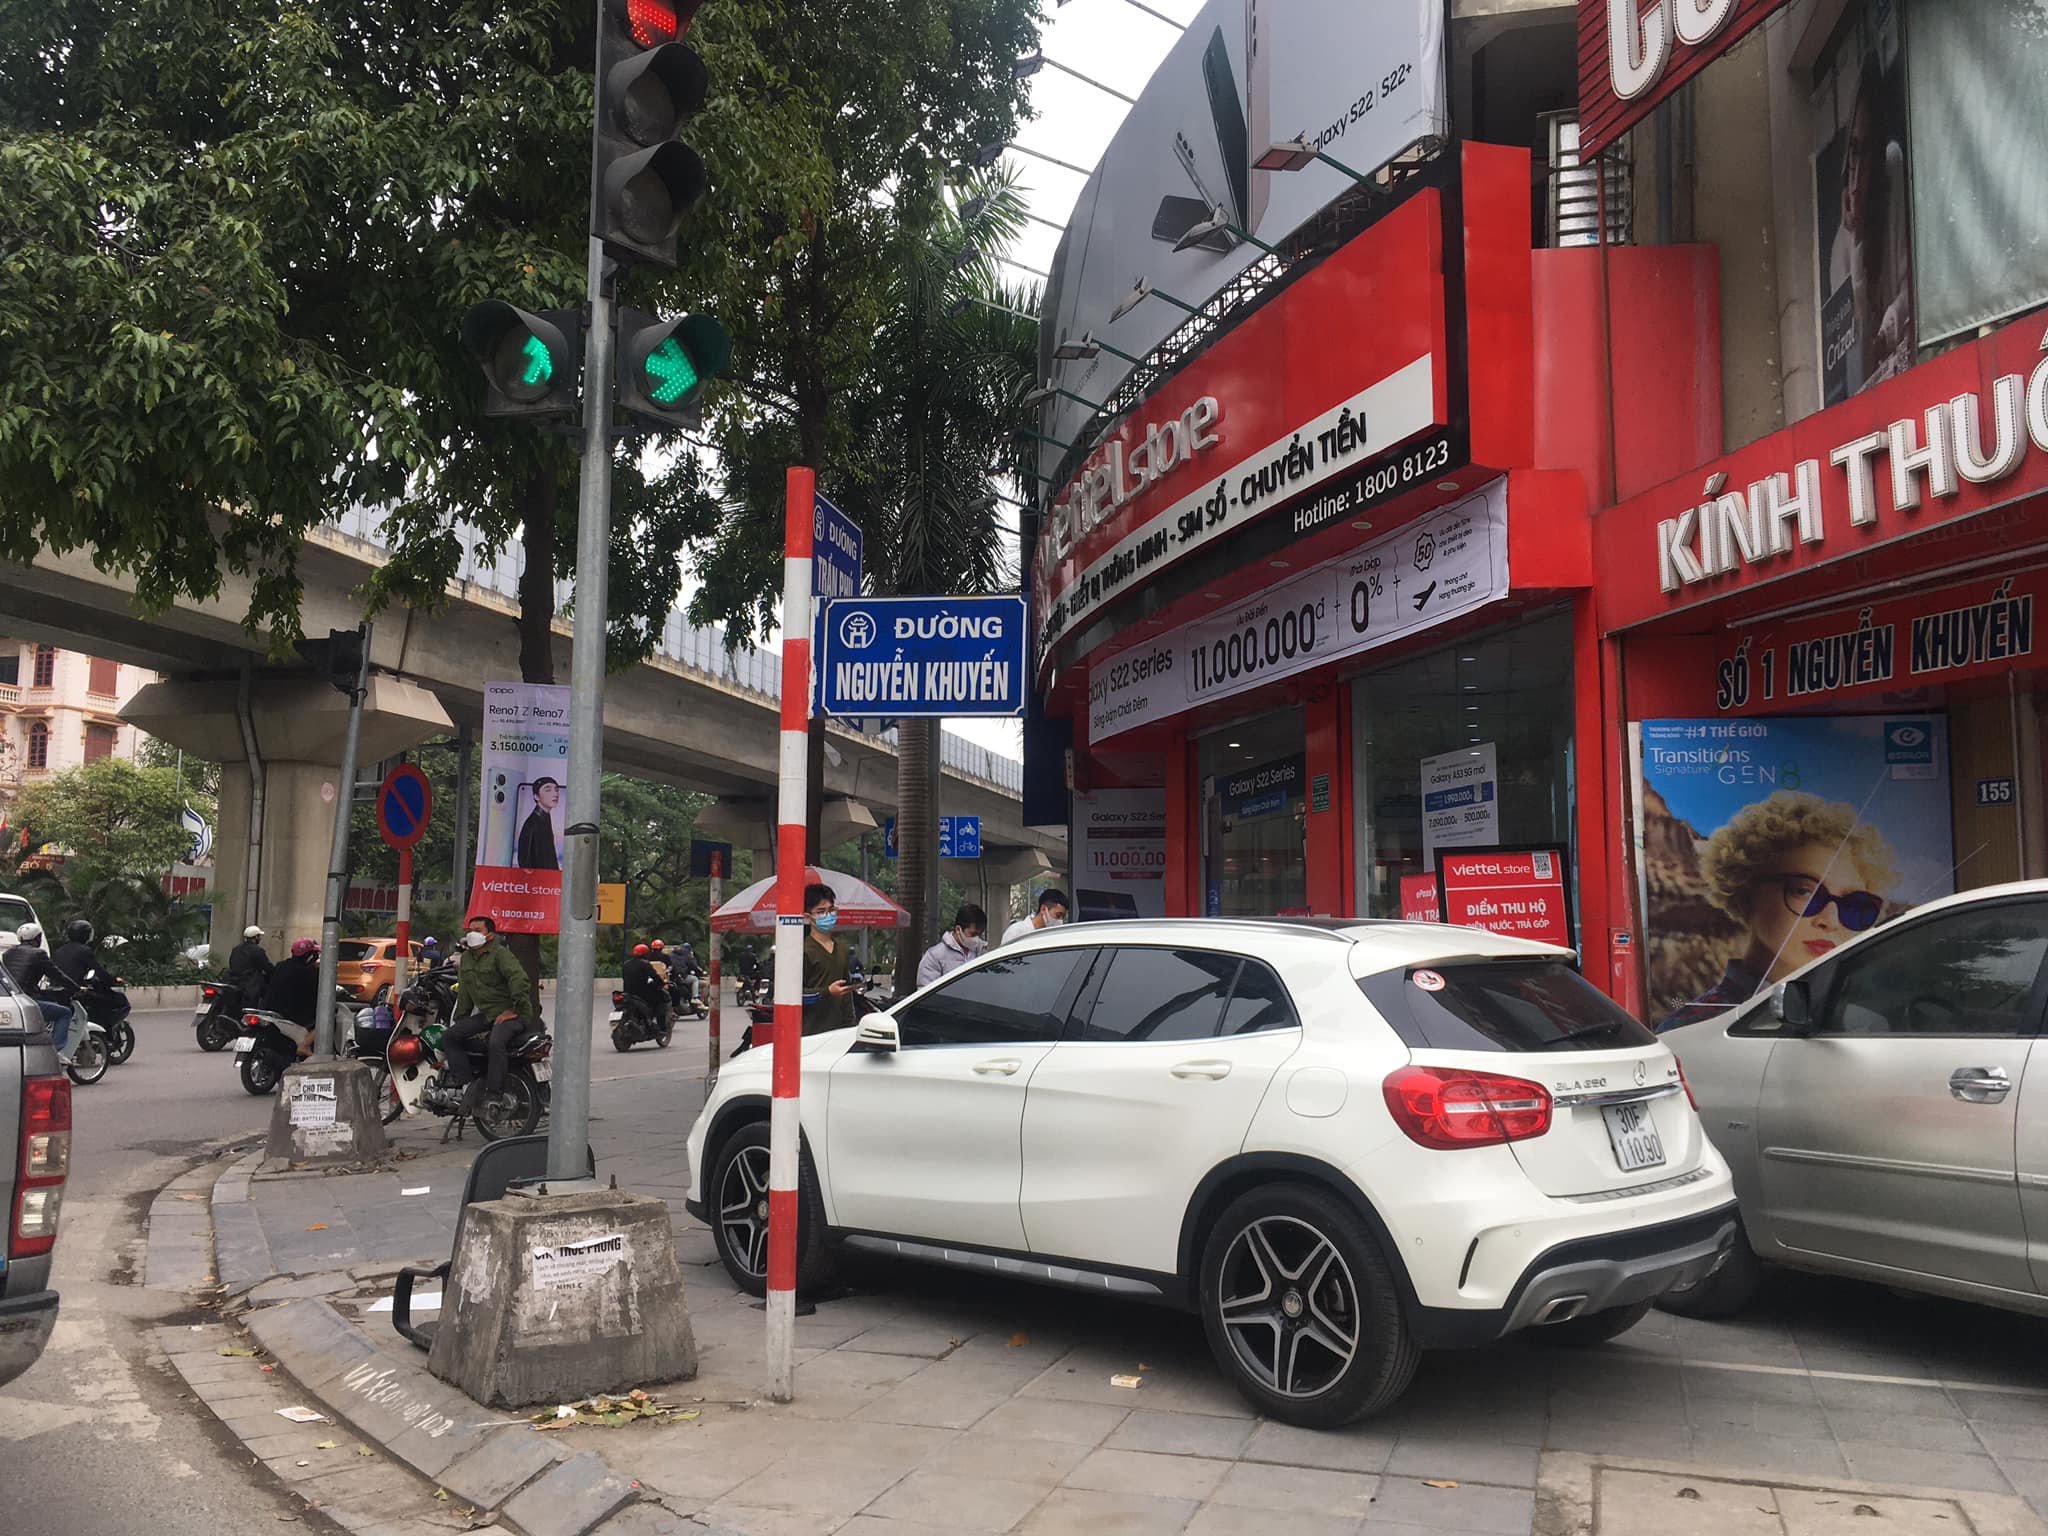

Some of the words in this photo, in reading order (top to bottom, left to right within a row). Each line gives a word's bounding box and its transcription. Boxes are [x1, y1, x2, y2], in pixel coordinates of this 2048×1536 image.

[1306, 112, 1348, 152] alaxy
[1350, 90, 1374, 125] S22
[1381, 63, 1413, 99] S22+
[1125, 396, 1220, 499] store
[1178, 506, 1204, 543] SIM
[1205, 478, 1228, 526] SỐ
[1240, 433, 1315, 507] CHUYỂN
[1293, 490, 1351, 533] Hotline:
[1355, 465, 1398, 504] 1800
[1402, 440, 1449, 483] 8123
[829, 520, 858, 562] ĐƯỜNG
[1657, 459, 1825, 594] KÍNH
[894, 610, 1003, 639] ĐƯỜNG
[1717, 637, 1751, 710] SỐ
[1761, 648, 1775, 700] 1
[1787, 606, 1894, 696] NGUYỄN
[1911, 577, 2033, 674] KHUYẾN
[835, 647, 919, 702] NGUYỄN
[924, 648, 1009, 702] KHUYẾN
[1110, 661, 1130, 693] S22
[1132, 648, 1173, 683] Series
[489, 704, 519, 716] Reno7
[522, 706, 530, 717] Z
[532, 707, 564, 719] Reno7
[1685, 725, 1707, 739] #1
[1710, 722, 1736, 738] THẾ
[1738, 724, 1768, 738] GIỚI
[1650, 745, 1750, 764] Transitions
[1229, 776, 1256, 797] Galaxy
[1256, 771, 1270, 788] S22
[1270, 763, 1296, 784] Series
[1654, 763, 1711, 776] Signature
[1717, 764, 1776, 785] GEN
[1780, 759, 1802, 791] 8
[1980, 781, 2010, 802] 155
[1091, 811, 1129, 824] Galaxy
[1130, 811, 1148, 822] S22
[1452, 862, 1503, 876] viettel
[1503, 864, 1531, 875] store
[481, 880, 530, 894] viettel
[531, 886, 561, 896] store
[1406, 911, 1424, 921] QUA
[1466, 897, 1498, 916] ĐIỂM
[1501, 902, 1526, 915] THU
[1529, 898, 1547, 916] HỘ
[1515, 917, 1532, 930] TRẢ
[1533, 917, 1550, 930] GÓP
[302, 1084, 316, 1094] CHO
[1615, 1105, 1641, 1135] 30F
[1618, 1134, 1663, 1167] 110.90
